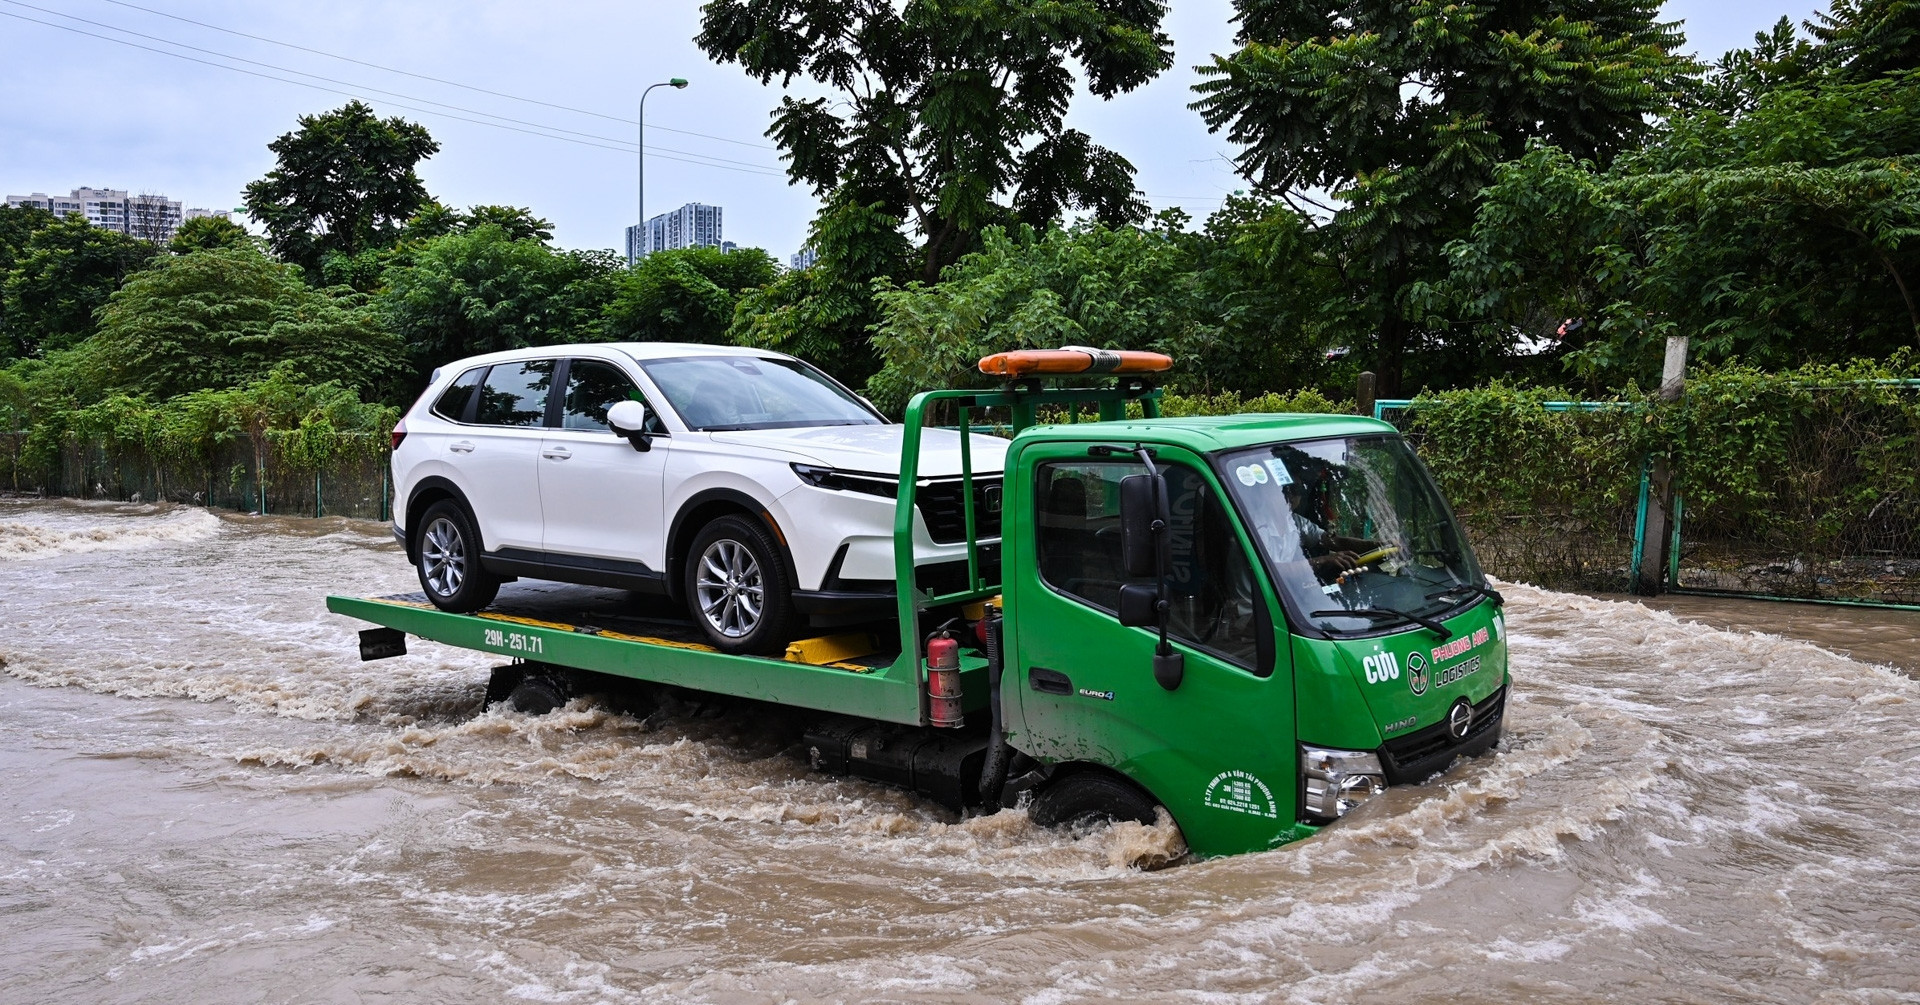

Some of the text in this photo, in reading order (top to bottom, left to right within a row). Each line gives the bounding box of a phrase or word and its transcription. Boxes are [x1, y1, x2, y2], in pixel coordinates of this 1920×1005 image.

[1363, 645, 1399, 684] CỨU
[1435, 655, 1480, 688] LOGISTICS
[1385, 716, 1416, 733] HINO
